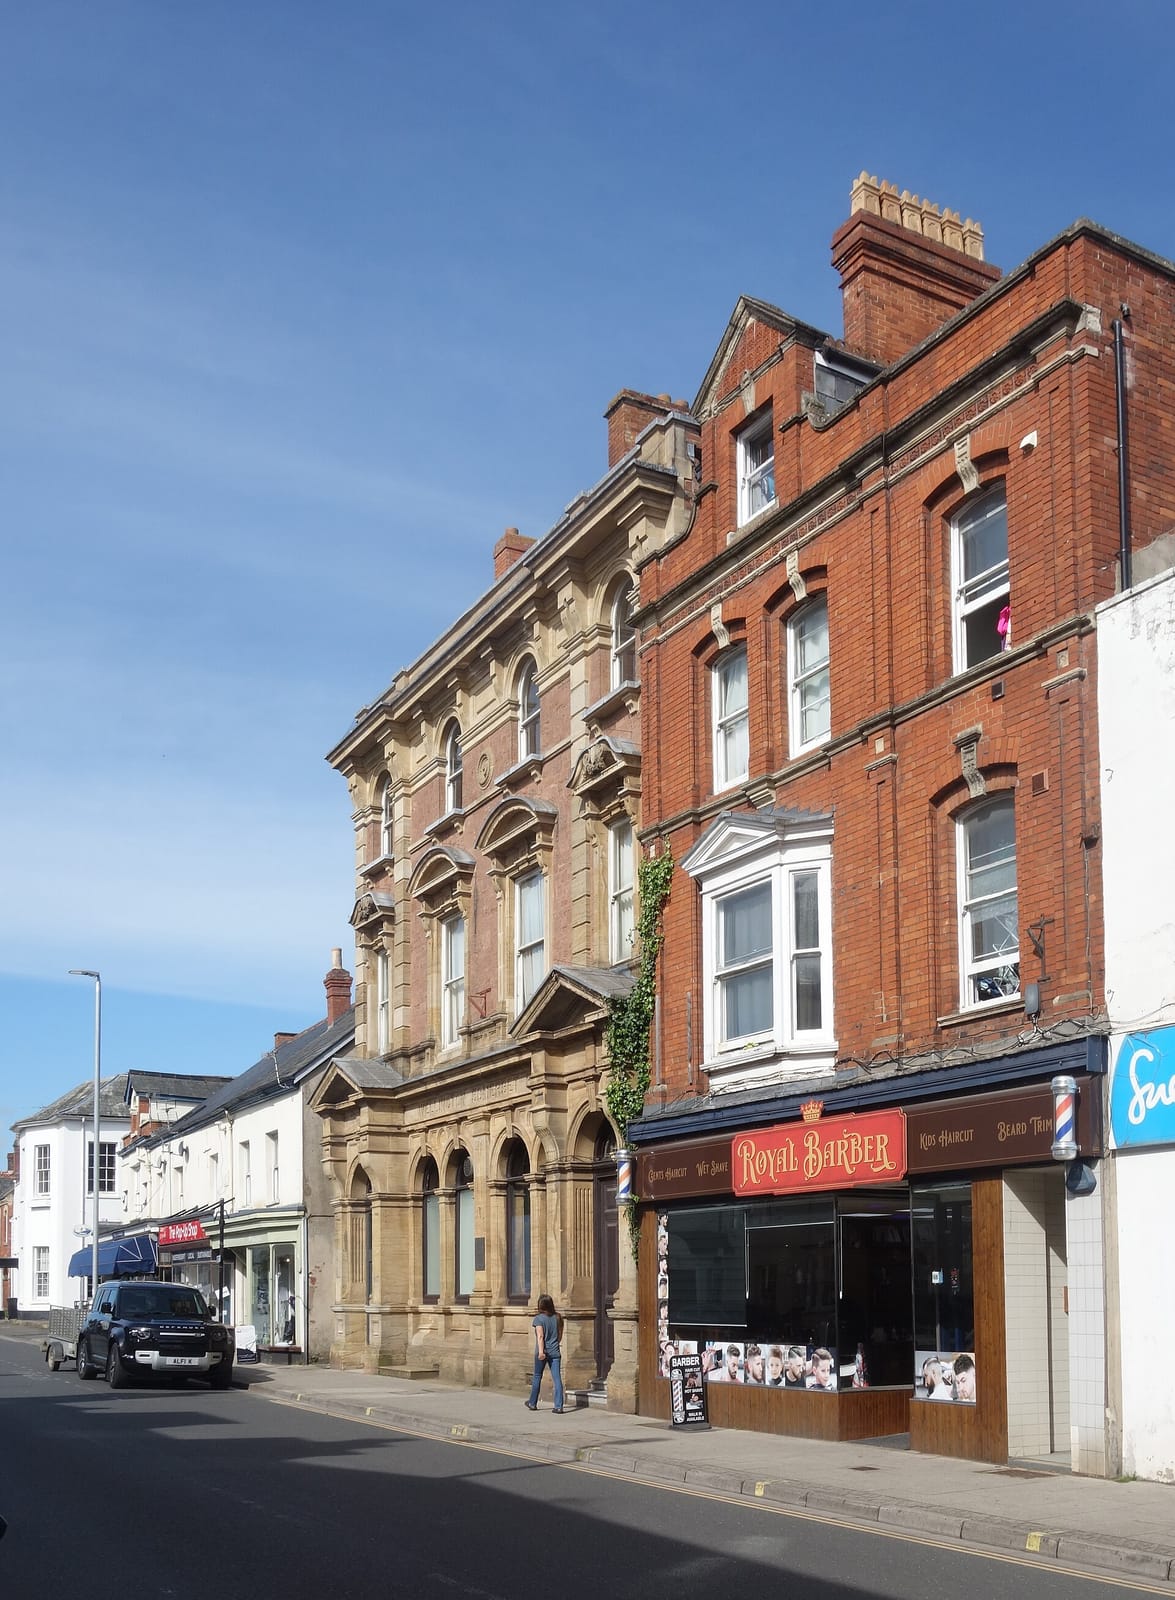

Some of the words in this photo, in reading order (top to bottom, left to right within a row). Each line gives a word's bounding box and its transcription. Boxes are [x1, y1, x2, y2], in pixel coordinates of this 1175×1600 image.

[997, 1121, 1027, 1141] BEARD
[1029, 1115, 1053, 1136] TRIM
[920, 1132, 936, 1151] KIDS
[938, 1129, 975, 1147] HAIRCUT
[737, 1138, 799, 1188] ROYAL
[803, 1129, 897, 1181] BARBER
[648, 1169, 664, 1183] GENTS
[665, 1166, 688, 1181] HAIRCUT
[696, 1160, 709, 1177] WET
[710, 1160, 729, 1176] SHAVE
[168, 1225, 176, 1239] The
[187, 1222, 198, 1239] Shop
[672, 1356, 700, 1367] BARBER
